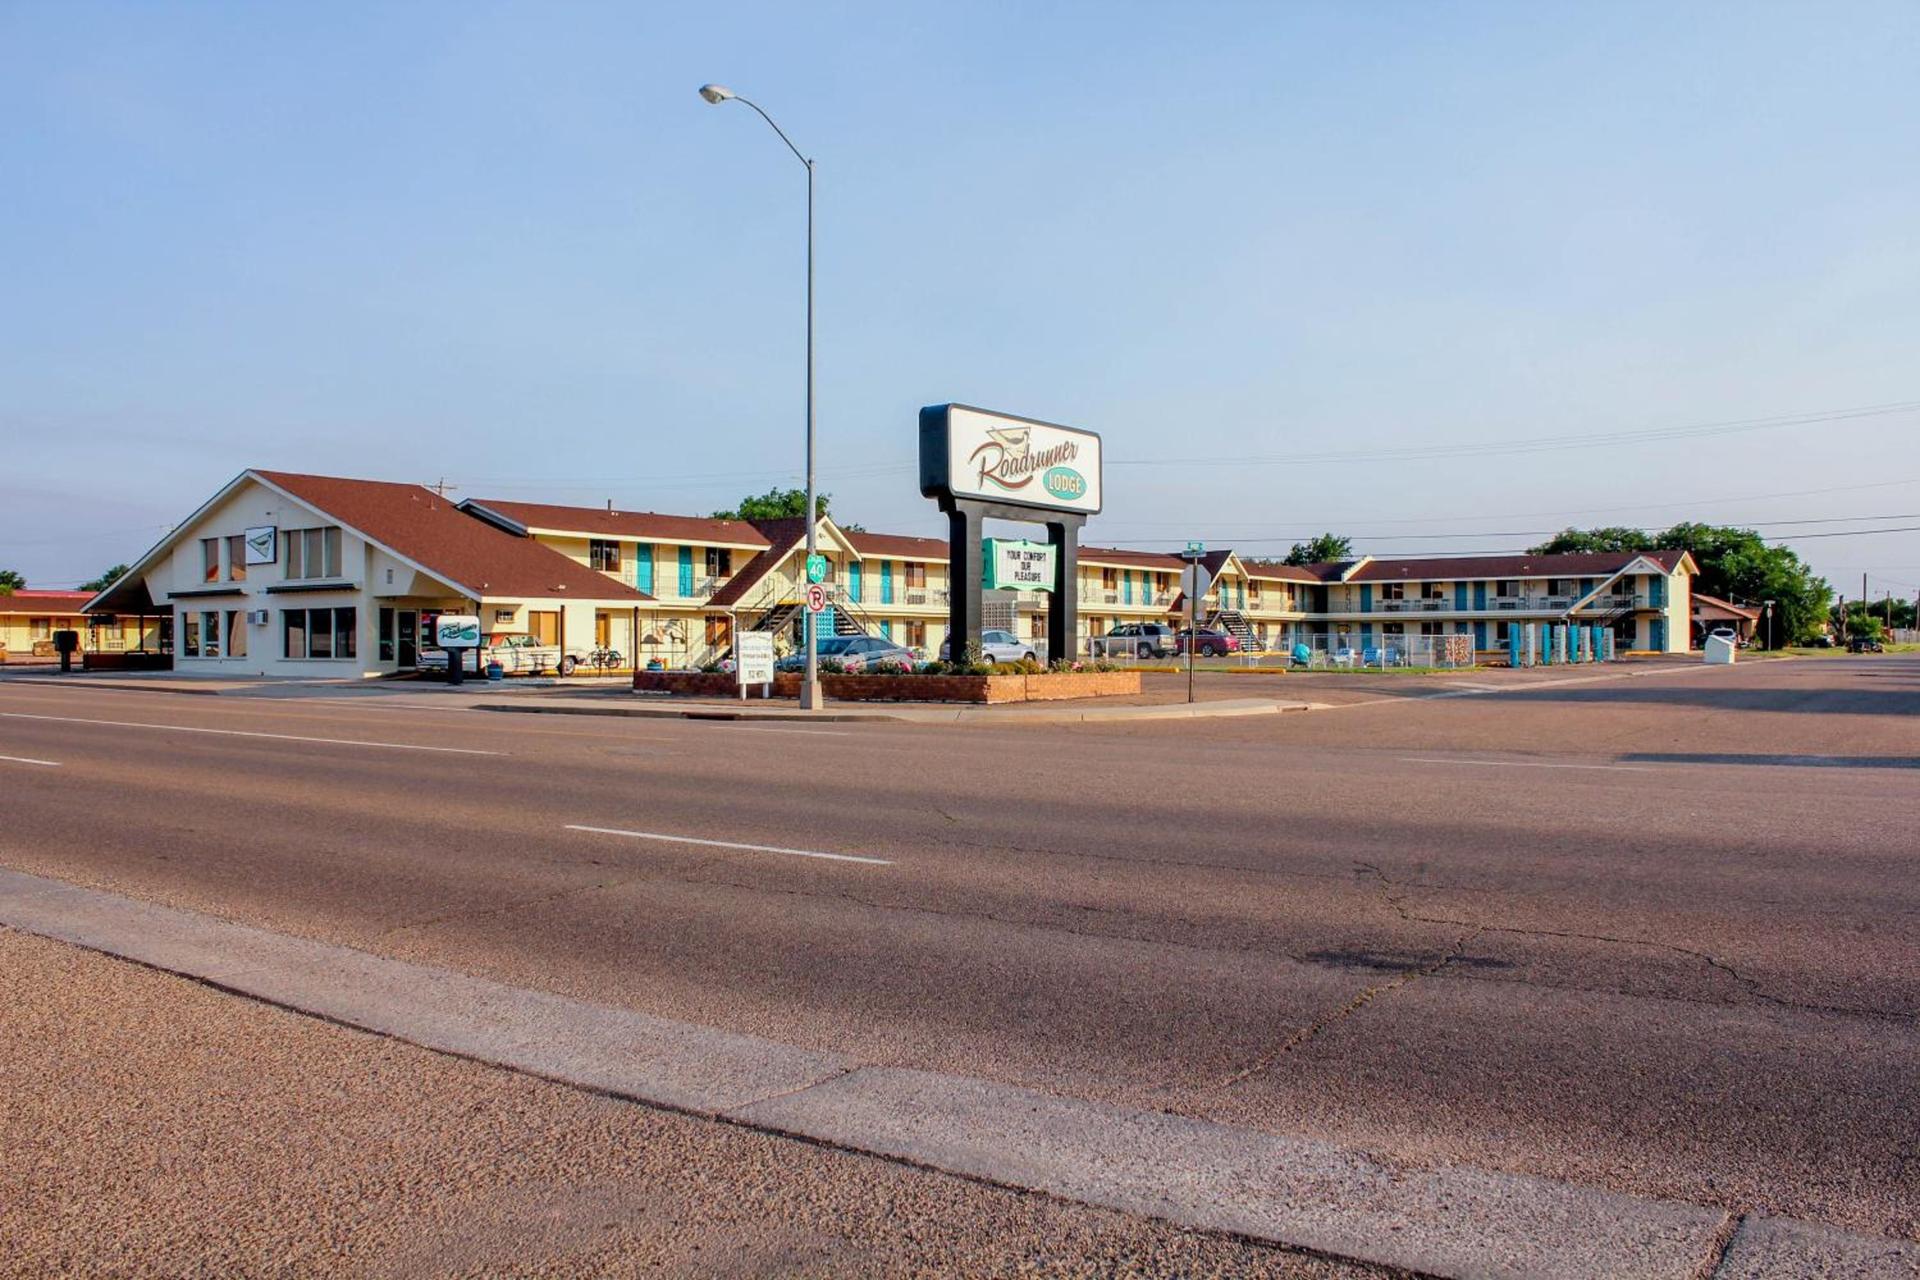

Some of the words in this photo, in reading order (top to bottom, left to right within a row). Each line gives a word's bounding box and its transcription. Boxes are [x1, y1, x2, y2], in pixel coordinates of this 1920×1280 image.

[968, 440, 1079, 491] Roadrunner
[1049, 472, 1081, 493] LODGE
[1007, 550, 1021, 560] YOUR
[810, 563, 823, 577] 40
[1021, 562, 1031, 571] OUR
[1014, 571, 1041, 582] PLEASURE
